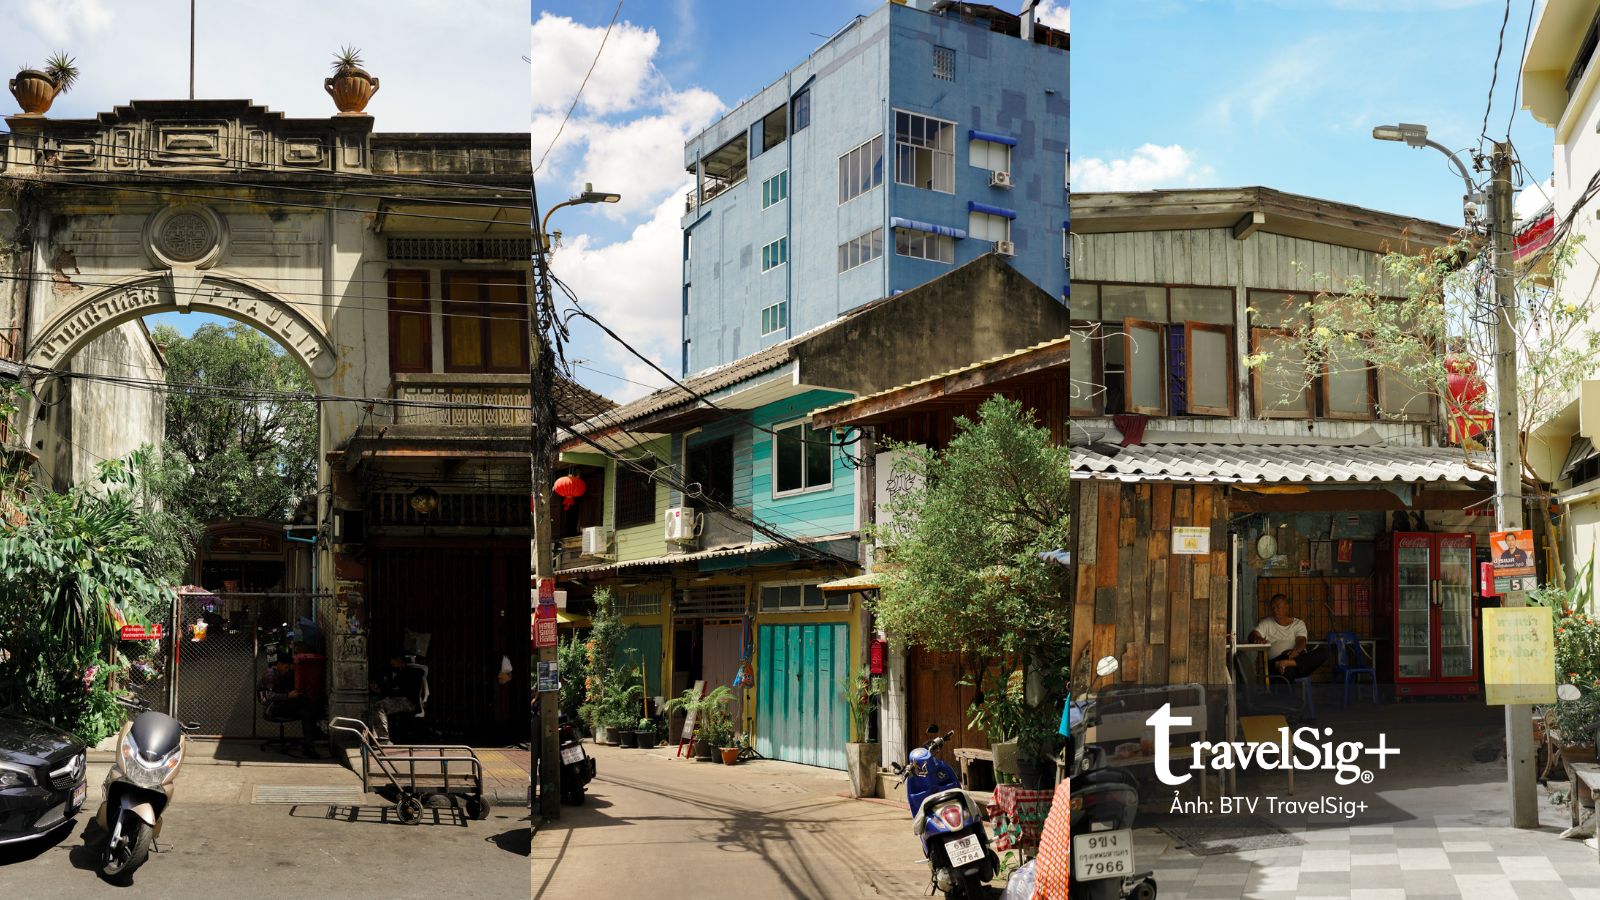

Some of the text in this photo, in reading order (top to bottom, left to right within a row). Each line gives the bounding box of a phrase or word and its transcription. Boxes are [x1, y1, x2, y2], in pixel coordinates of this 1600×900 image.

[208, 286, 324, 363] PHAULIM
[1512, 579, 1520, 590] 5
[956, 851, 979, 864] 3784
[1085, 860, 1124, 875] 7966
